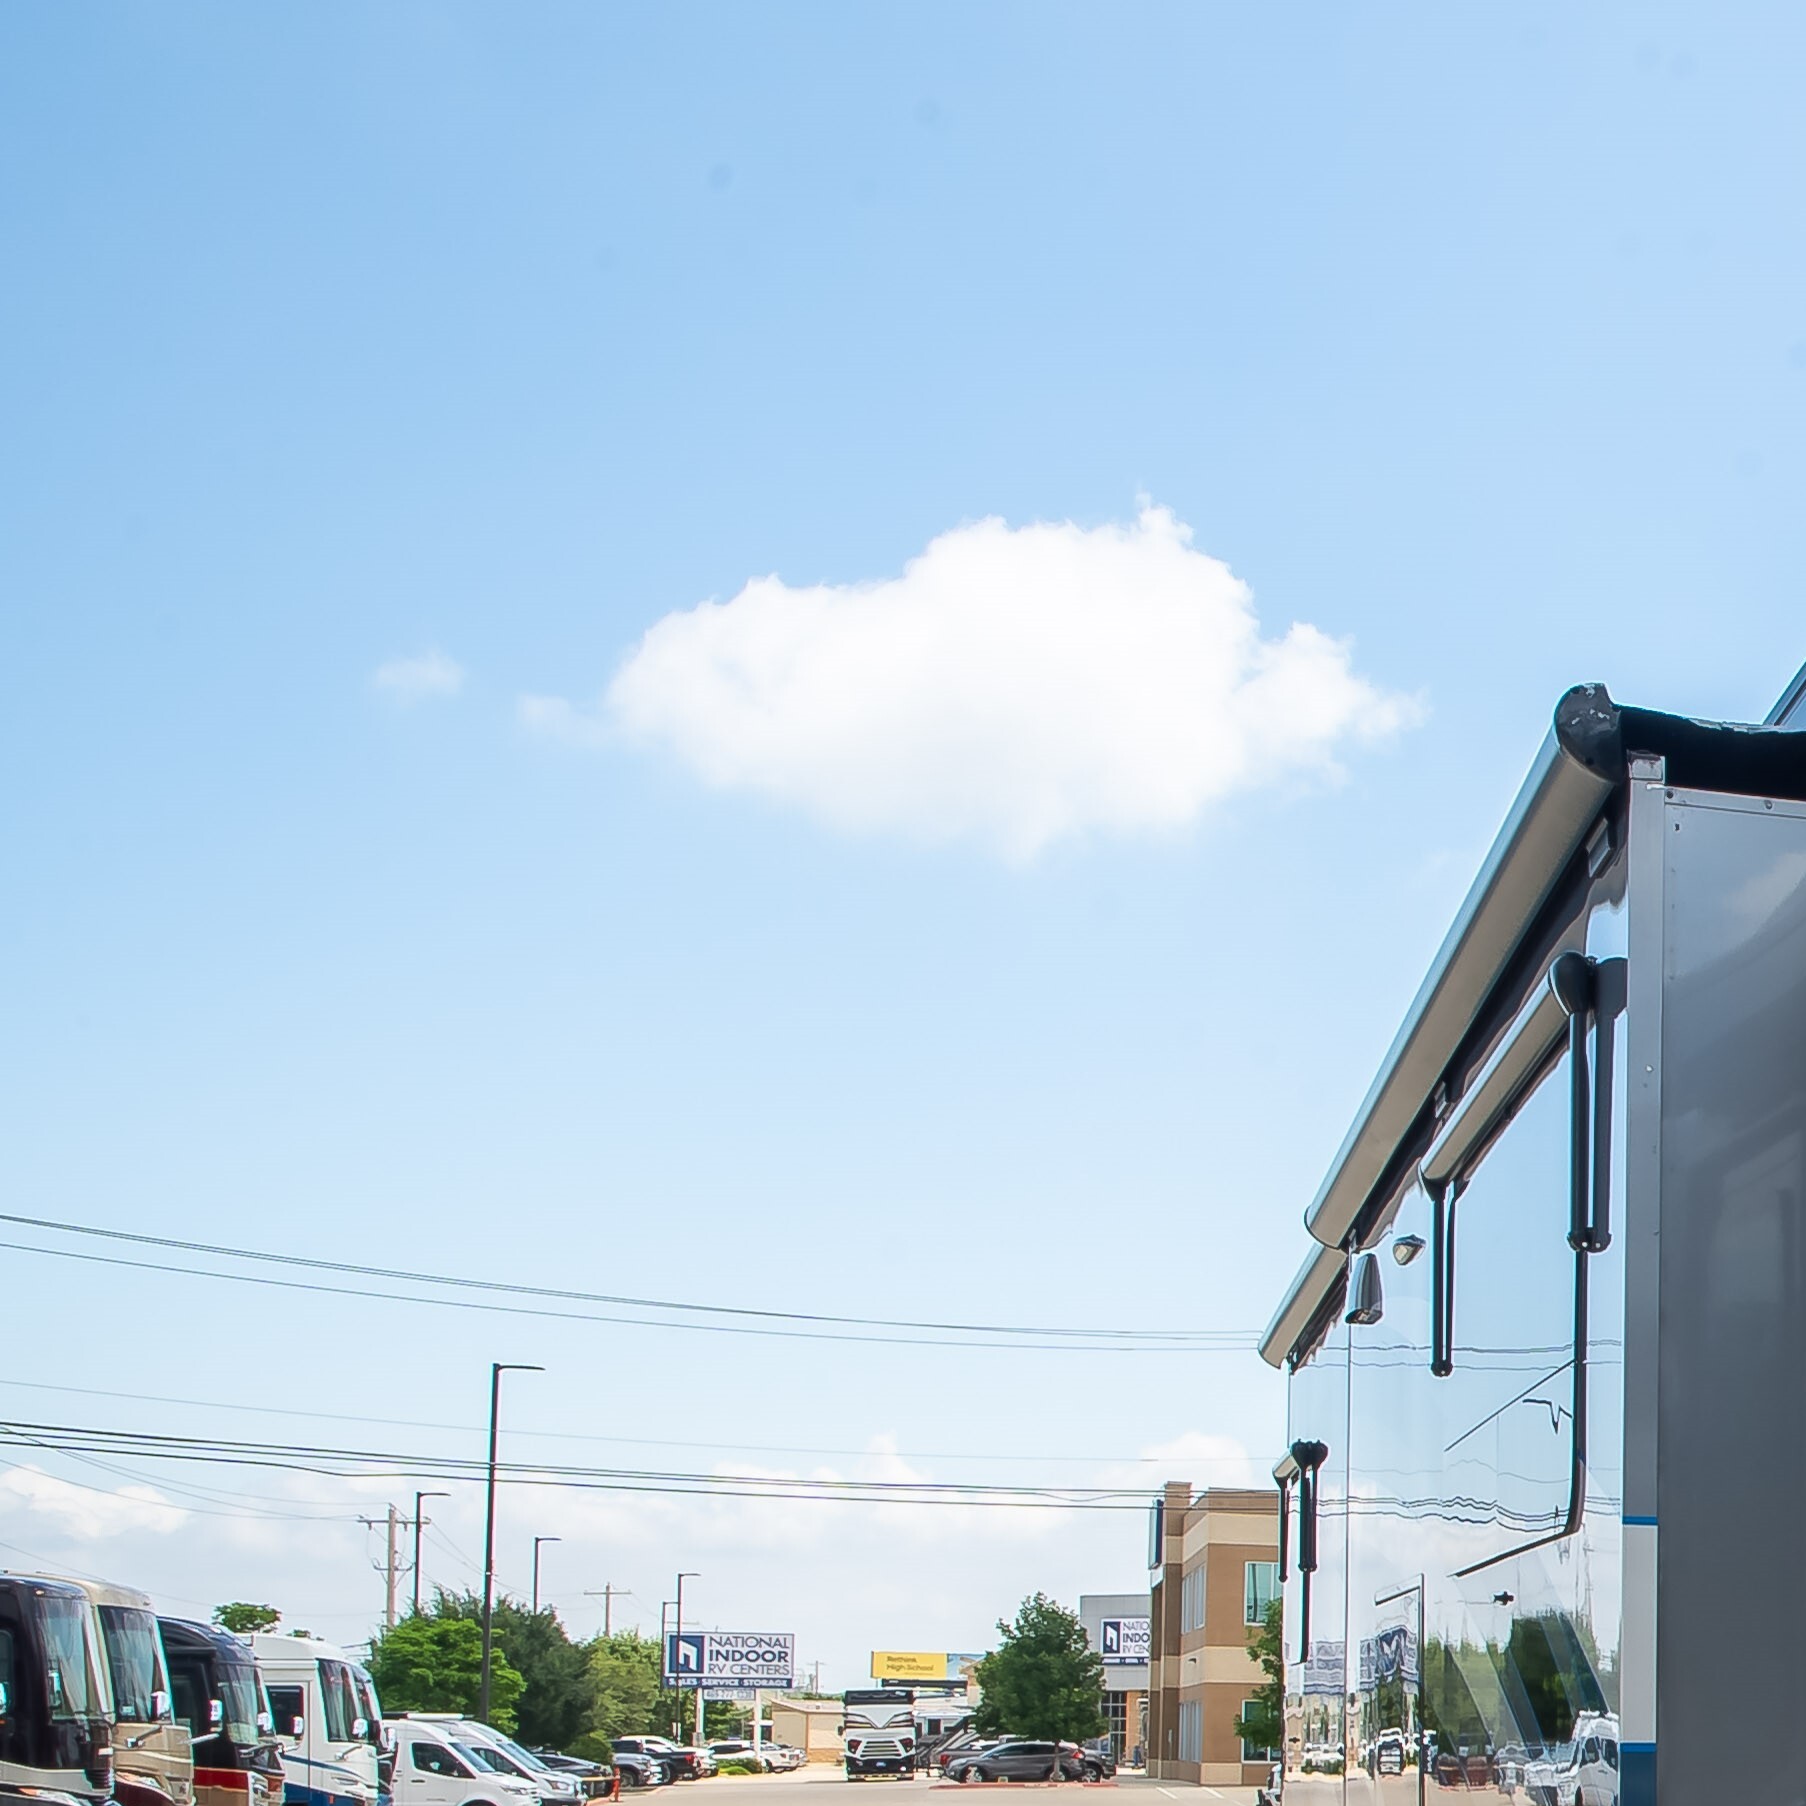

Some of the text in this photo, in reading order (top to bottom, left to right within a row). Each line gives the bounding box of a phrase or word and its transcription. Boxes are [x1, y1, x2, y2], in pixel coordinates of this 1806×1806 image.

[709, 1635, 790, 1649] NATIONAL
[1122, 1632, 1150, 1643] INDO
[709, 1649, 789, 1663] INDOOR
[708, 1663, 790, 1675] RV CENTERS
[701, 1678, 740, 1687] SERVICE
[743, 1678, 788, 1687] STORAGE
